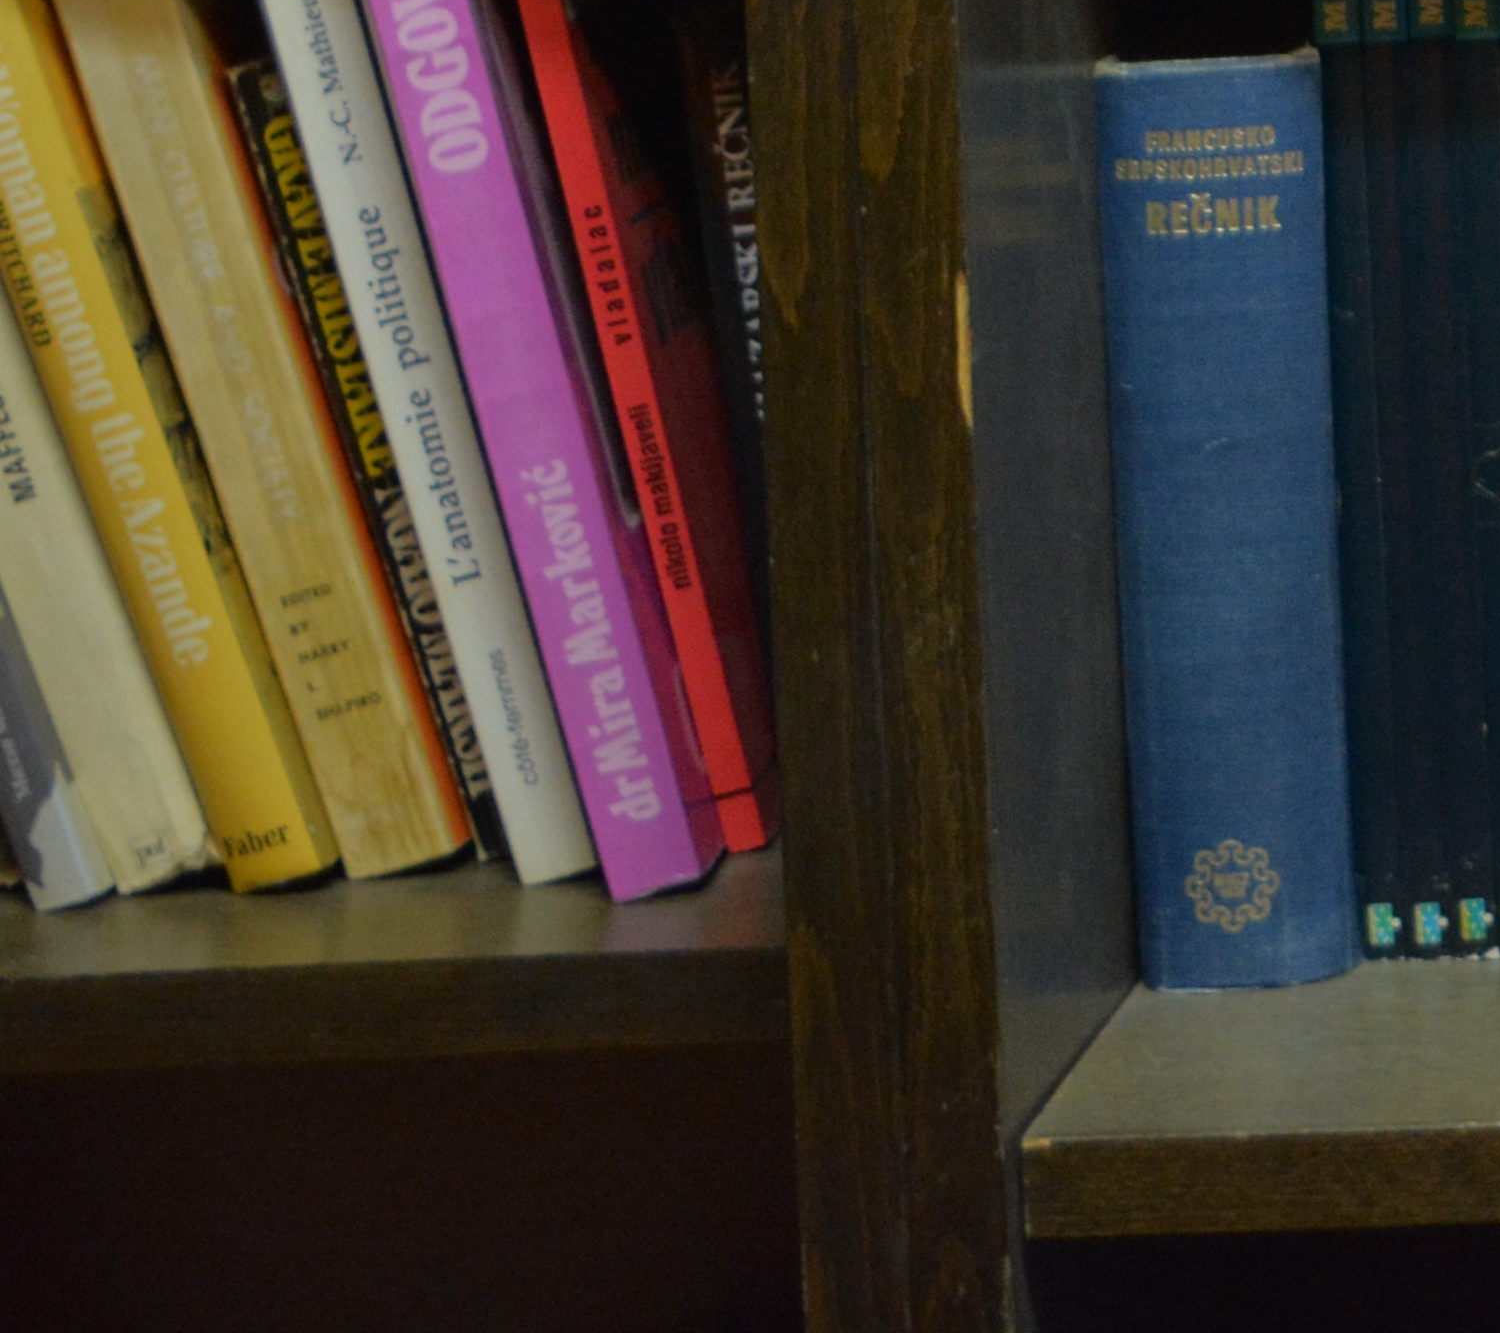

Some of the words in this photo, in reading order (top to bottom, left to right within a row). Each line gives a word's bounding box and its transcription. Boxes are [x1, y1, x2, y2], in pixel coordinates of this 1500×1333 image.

[1145, 190, 1285, 238] REČNIK
[357, 203, 431, 373] politique
[406, 387, 484, 589] L'anatomie
[518, 455, 615, 668] Marković
[586, 667, 651, 776] Mira
[223, 821, 290, 862] Faber
[608, 770, 663, 826] dr
